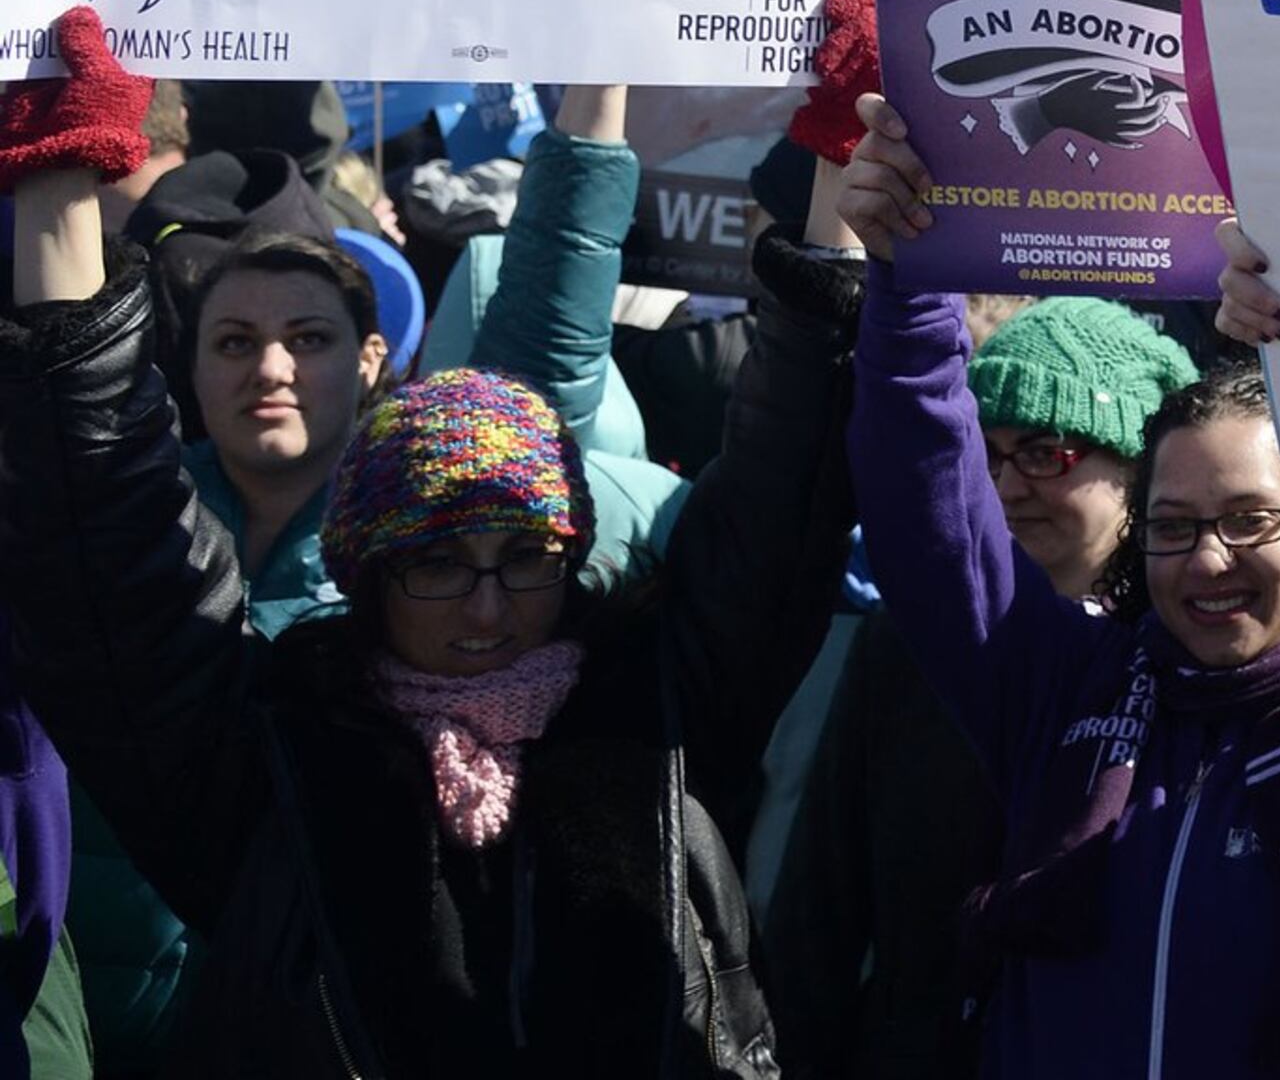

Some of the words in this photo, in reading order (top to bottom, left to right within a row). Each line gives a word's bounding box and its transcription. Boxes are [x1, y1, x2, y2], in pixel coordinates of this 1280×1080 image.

[678, 14, 836, 42] REPRODUCTIV
[962, 9, 1013, 43] AN
[1030, 8, 1181, 60] ABORTIO
[0, 28, 57, 60] WHOL
[103, 28, 192, 60] OMAN'S
[203, 30, 289, 61] HEALTH
[761, 46, 817, 73] RIGH
[1027, 189, 1157, 212] ABORTION
[656, 188, 746, 248] WE
[1001, 232, 1074, 248] NATIONAL
[1077, 235, 1149, 250] NETWORK
[1151, 237, 1171, 251] OF
[1002, 249, 1103, 267] ABORTION
[1107, 252, 1172, 269] FUNDS
[1018, 268, 1156, 285] @ABORTIONFUNDS
